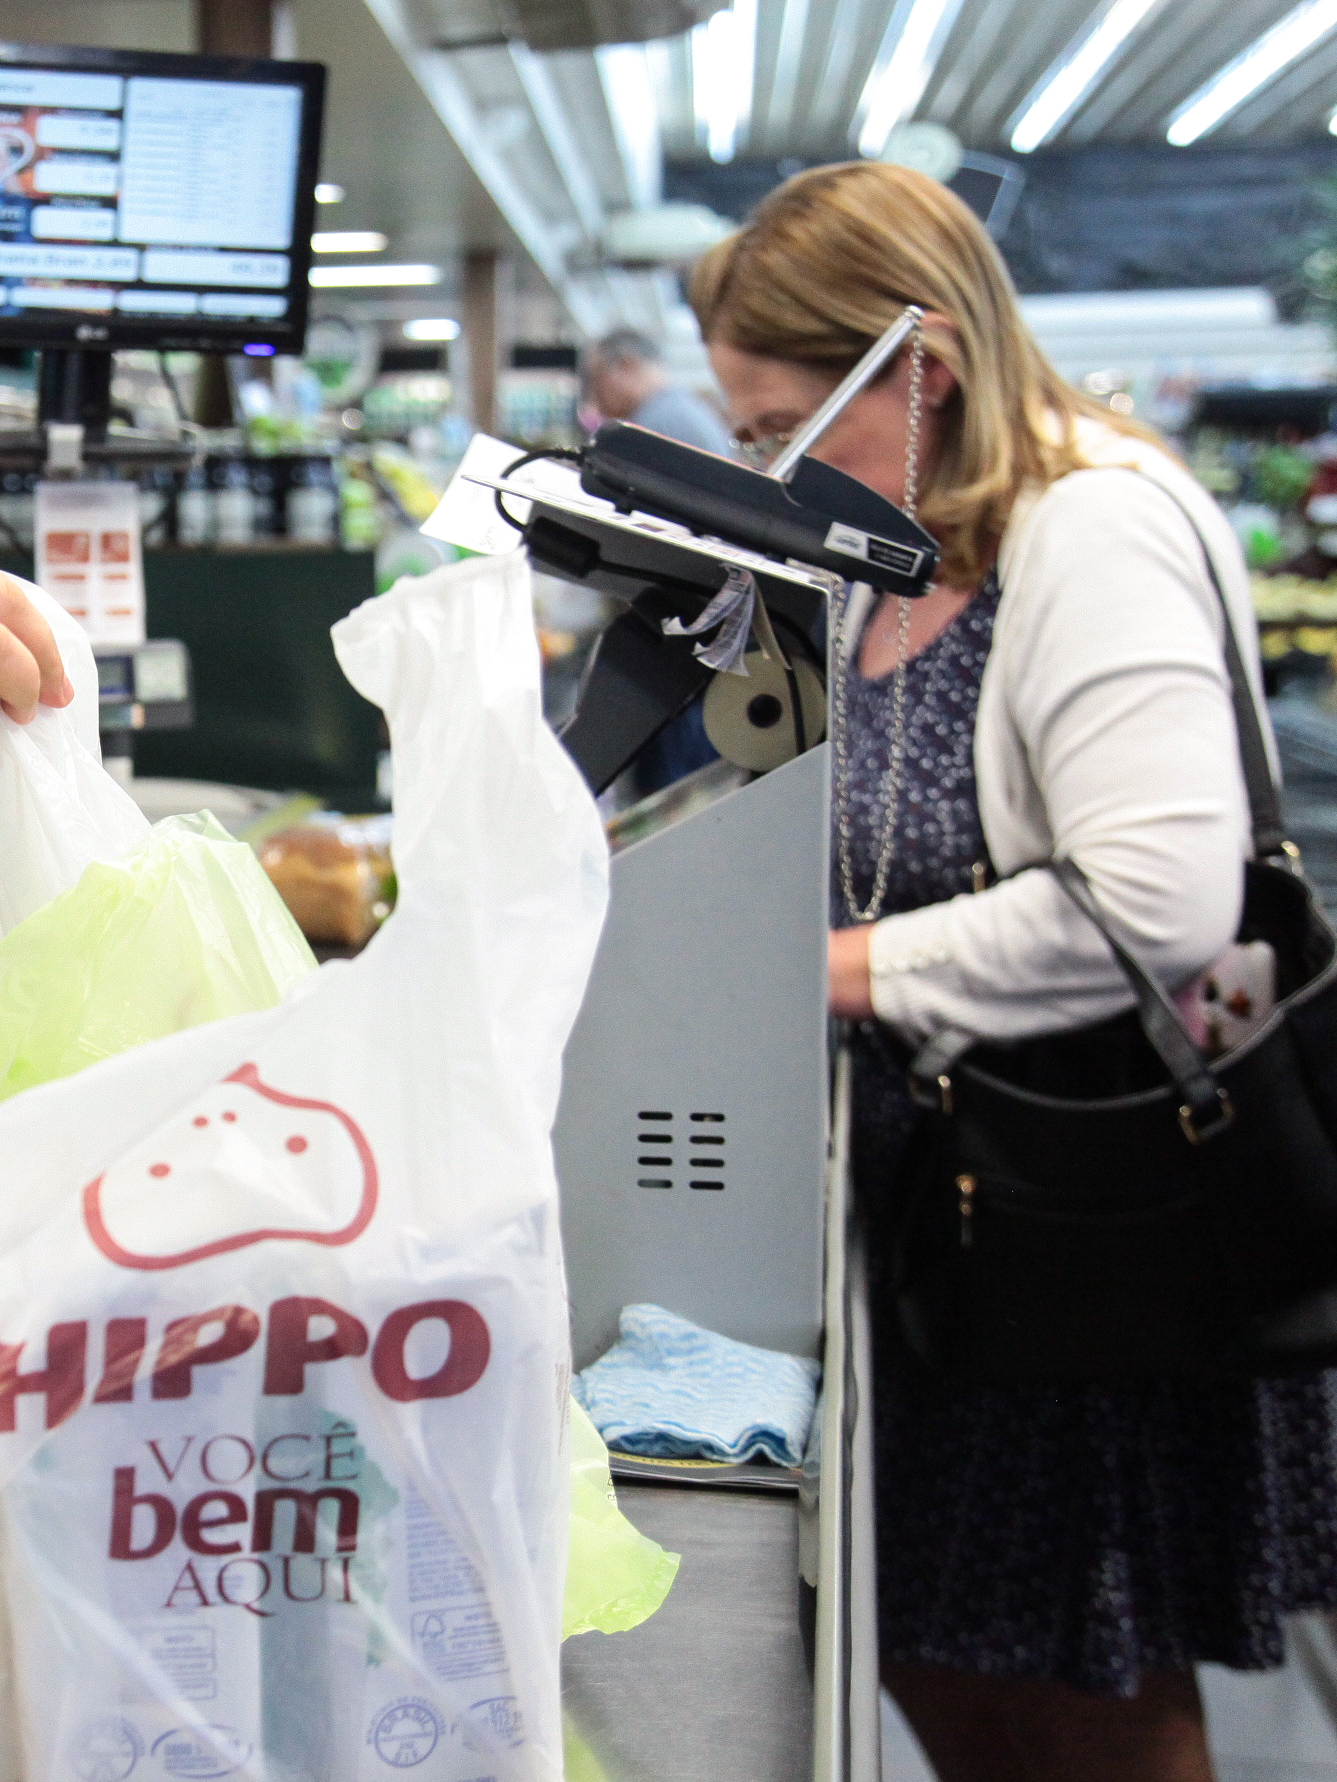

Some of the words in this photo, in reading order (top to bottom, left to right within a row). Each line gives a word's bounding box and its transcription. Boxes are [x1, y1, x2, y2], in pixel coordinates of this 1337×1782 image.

[145, 1421, 360, 1486] VOCÊ
[109, 1466, 360, 1561] bem
[162, 1553, 358, 1618] AQUI
